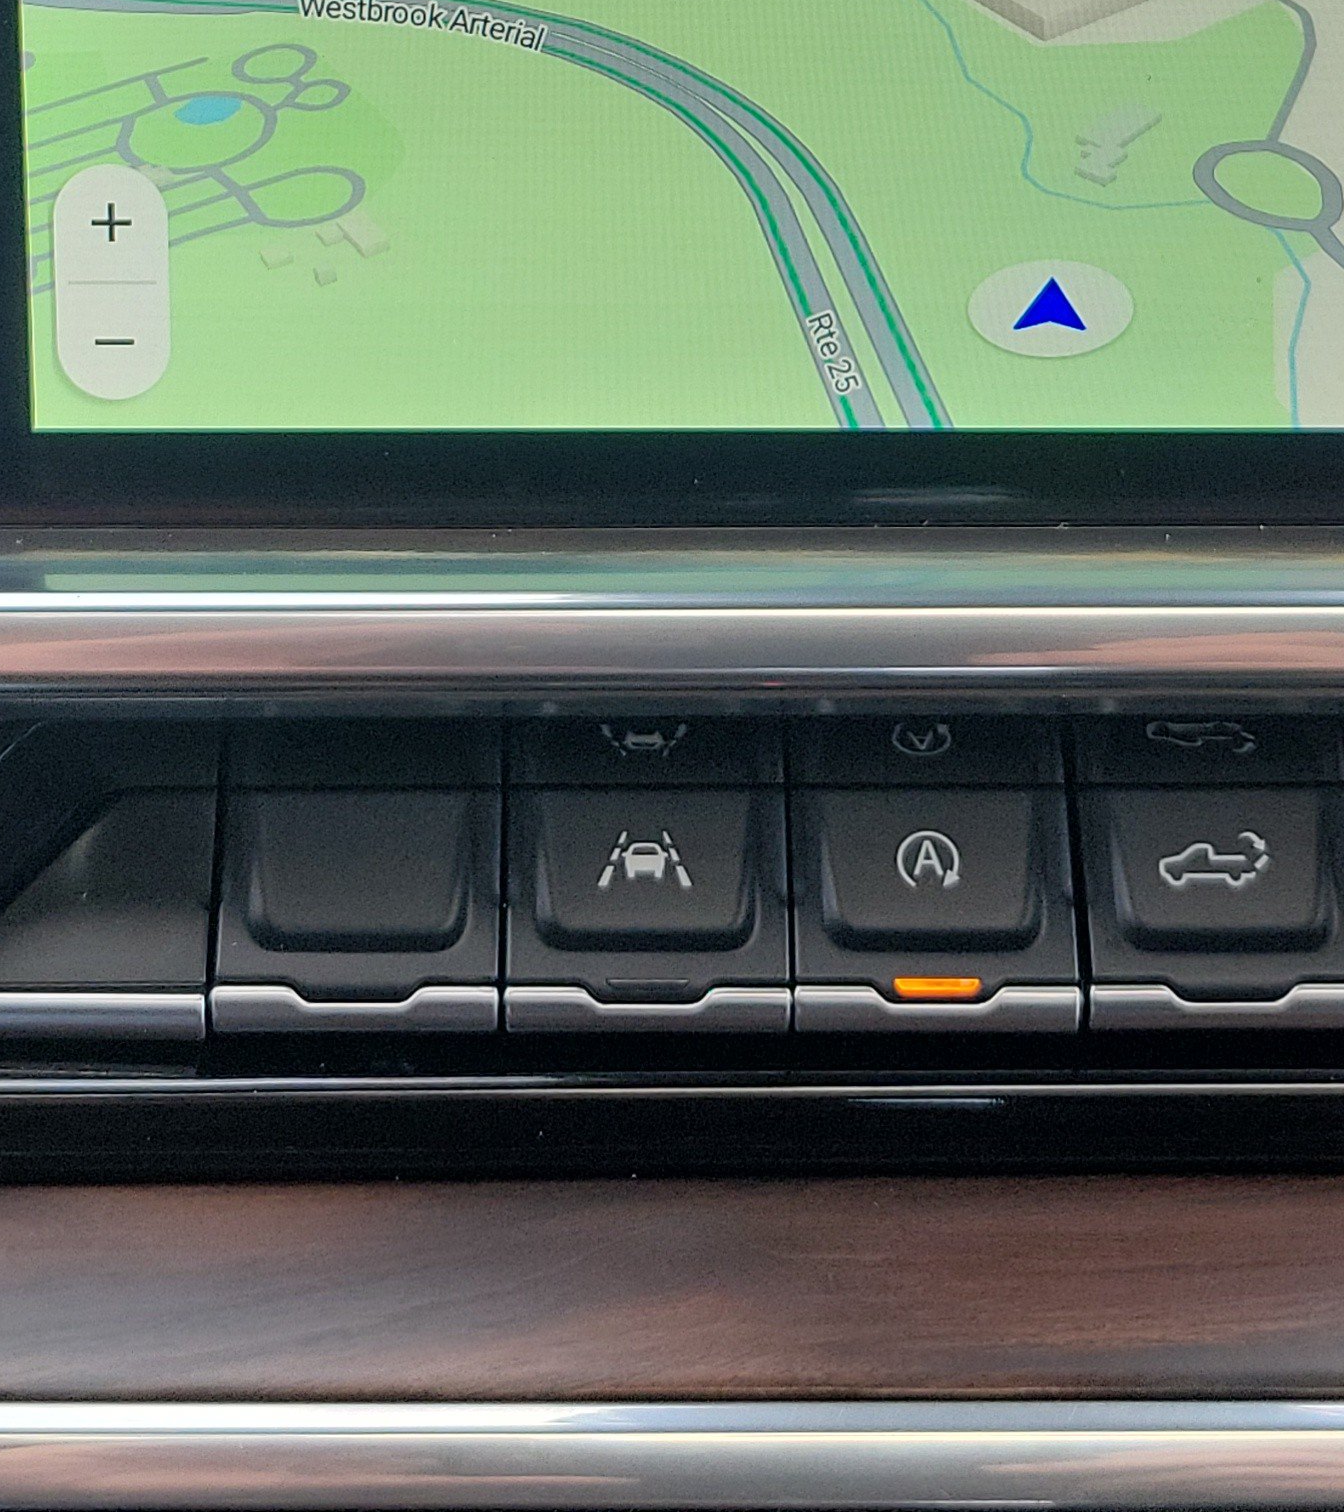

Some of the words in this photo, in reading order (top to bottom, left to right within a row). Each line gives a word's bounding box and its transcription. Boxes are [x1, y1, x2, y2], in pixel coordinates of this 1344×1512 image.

[449, 8, 547, 52] Arterial
[808, 313, 839, 357] Rte
[827, 359, 859, 393] 25
